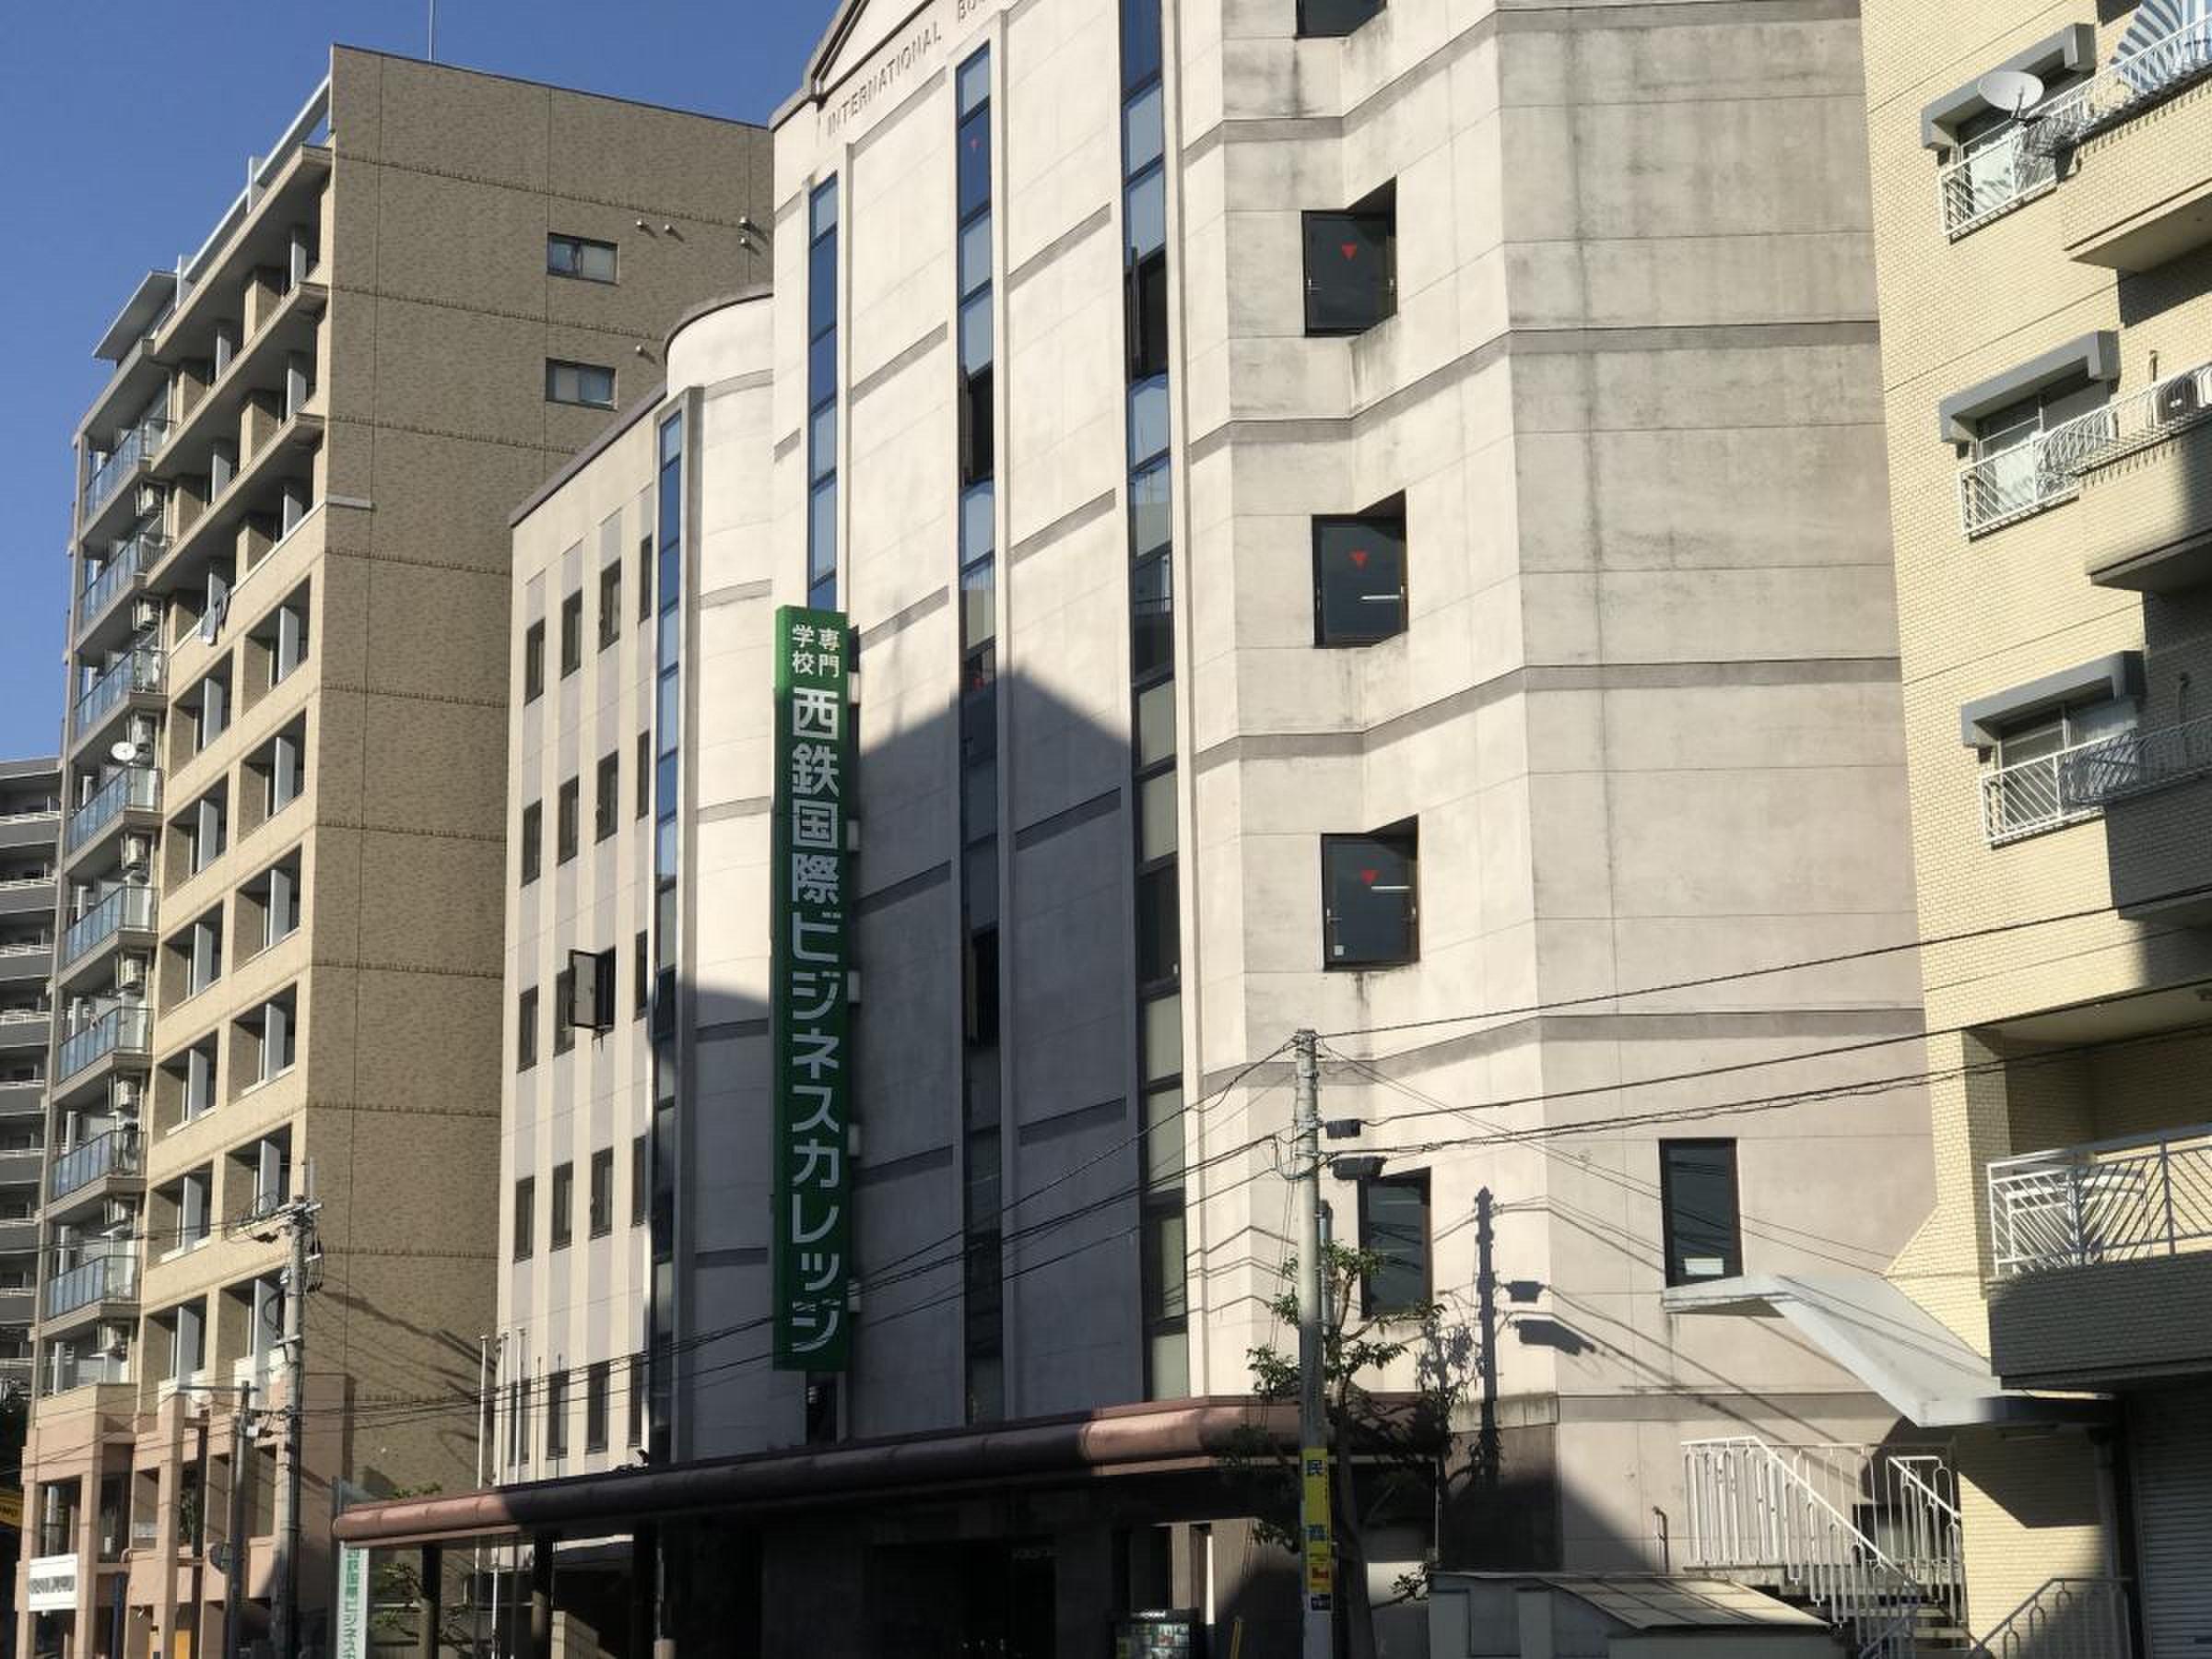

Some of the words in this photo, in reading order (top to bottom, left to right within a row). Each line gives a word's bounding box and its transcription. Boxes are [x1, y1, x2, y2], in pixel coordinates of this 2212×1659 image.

[827, 20, 943, 136] INTERNATIONAL
[792, 687, 841, 1352] 西鉄国際ビジネスカレッジ
